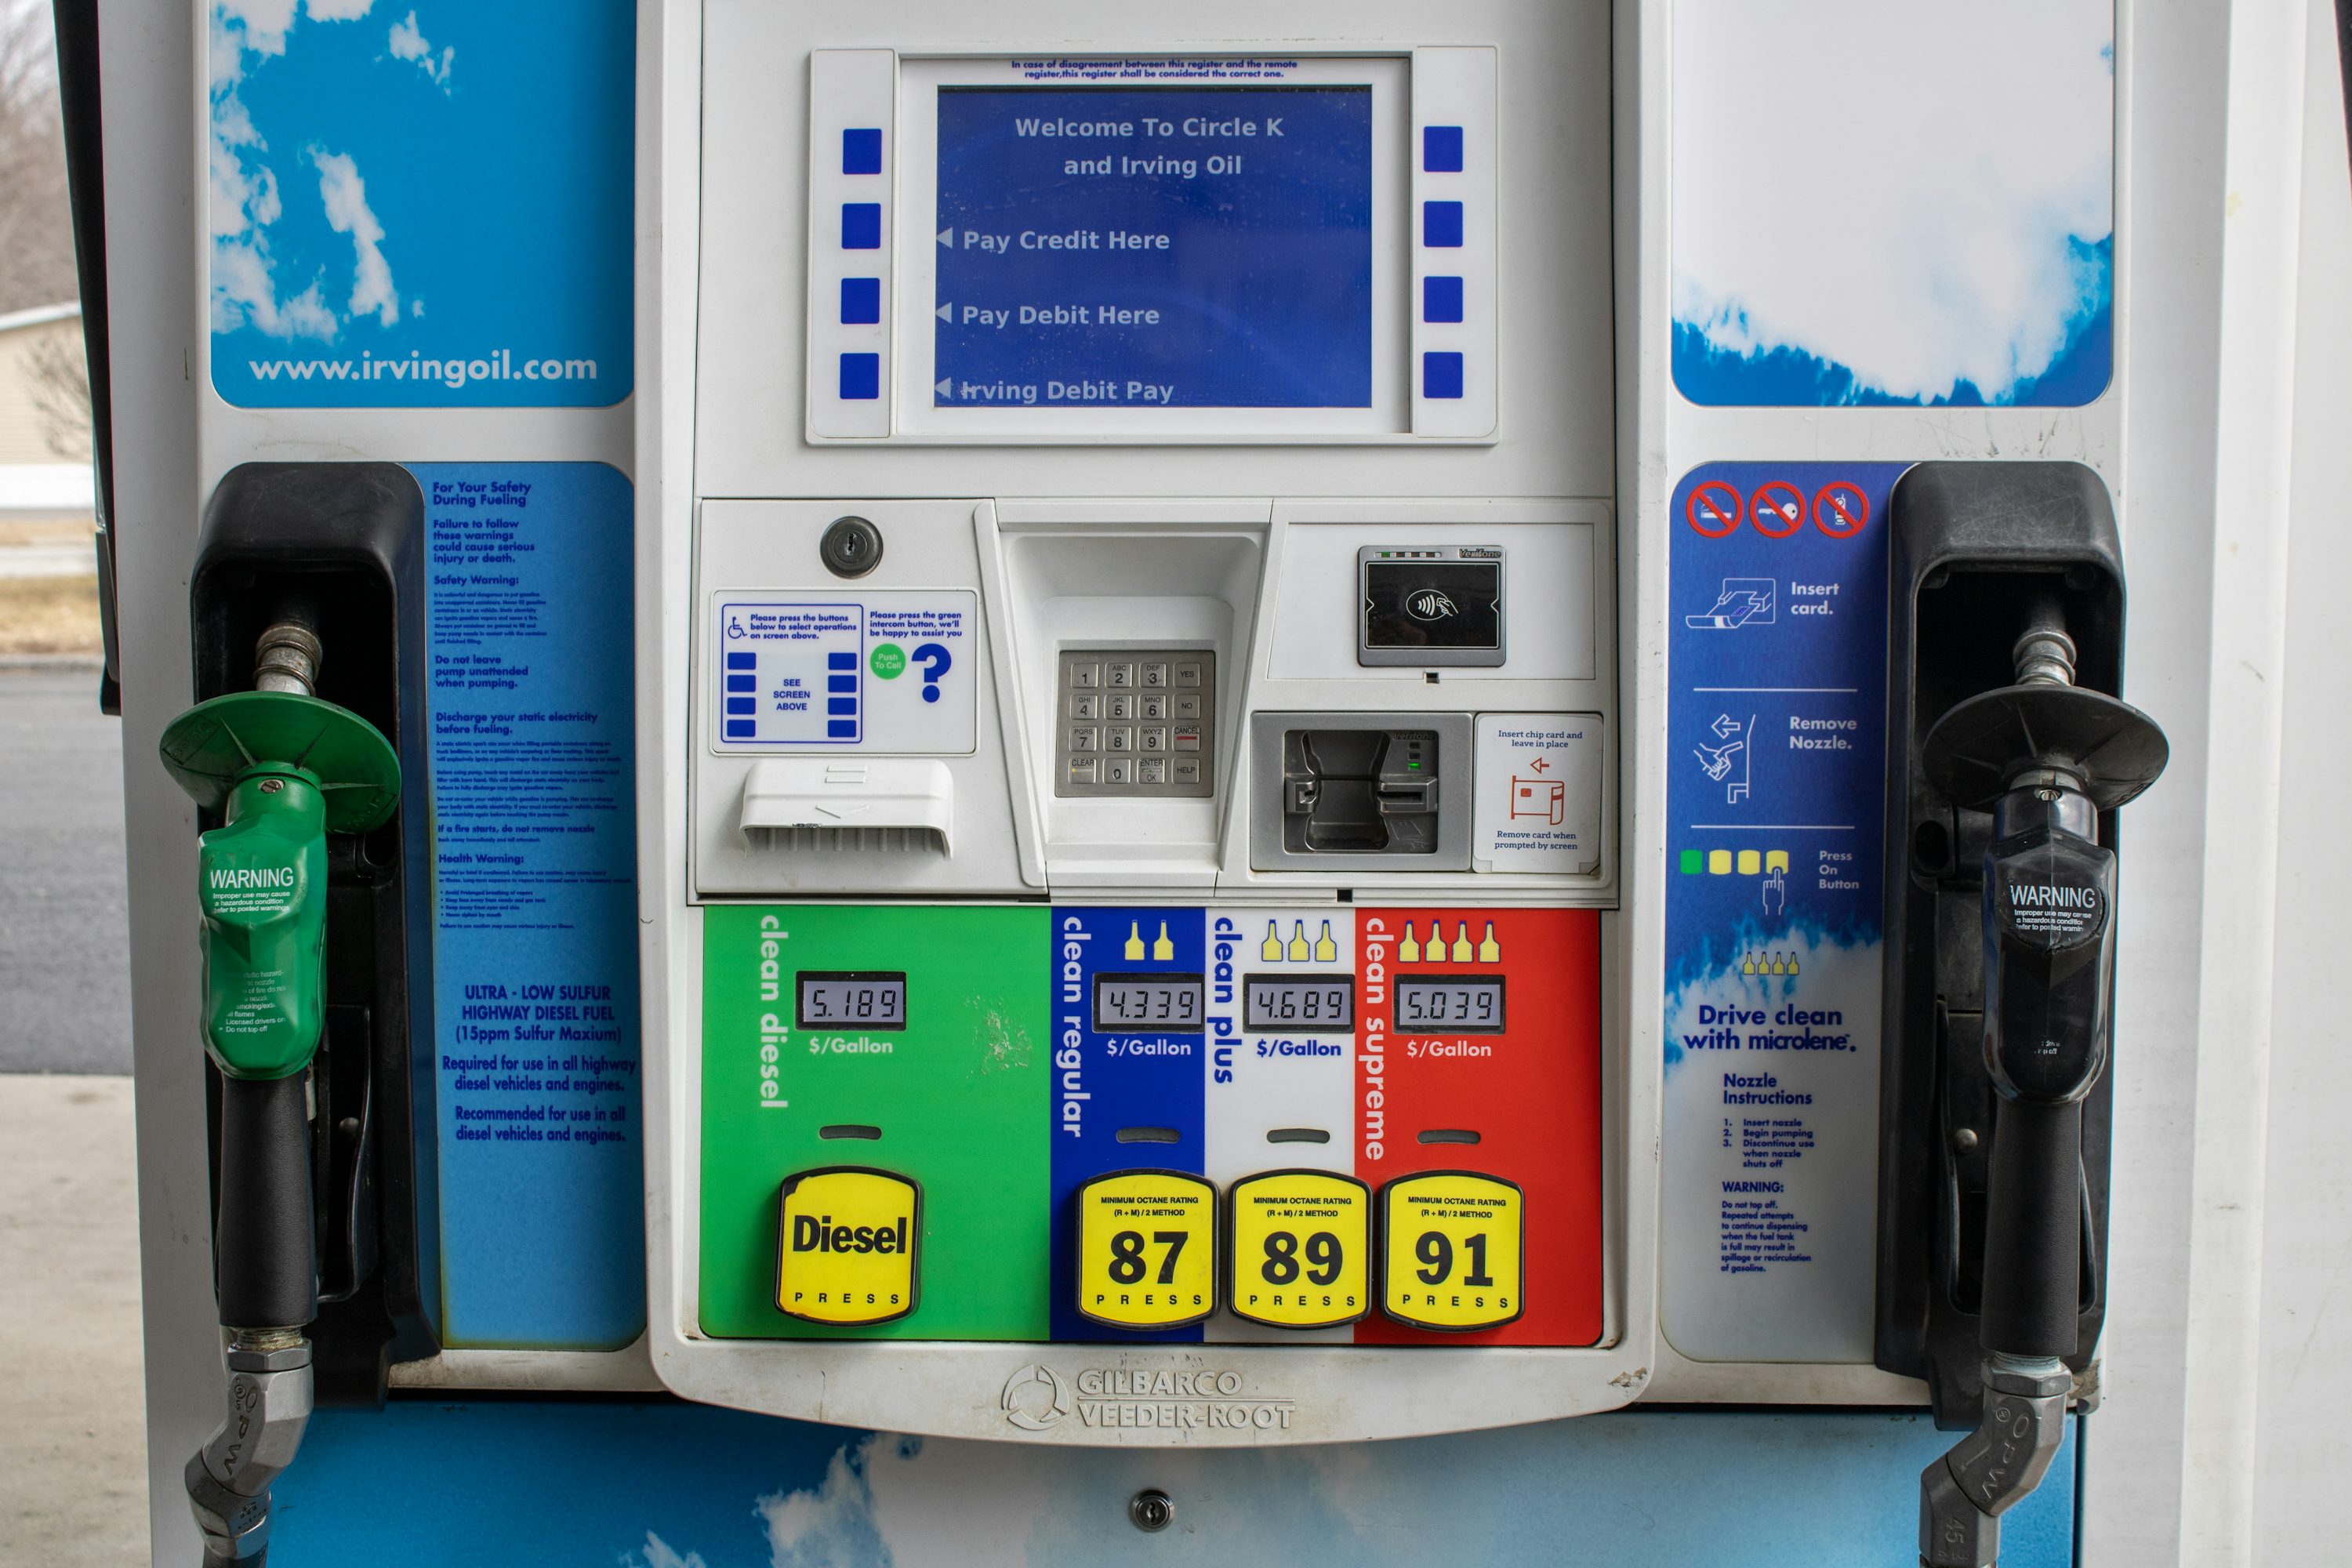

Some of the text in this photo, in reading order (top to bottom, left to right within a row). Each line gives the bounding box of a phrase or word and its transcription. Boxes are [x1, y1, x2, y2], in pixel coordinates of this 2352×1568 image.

[1059, 61, 1122, 70] disagreement
[1188, 61, 1223, 70] register
[1082, 70, 1116, 79] register
[1016, 118, 1284, 136] Welcome To Circle K
[1065, 155, 1240, 179] and Irving Oil
[964, 230, 1170, 254] Pay Credit Here
[964, 306, 1159, 328] Pay Debit Here
[249, 350, 596, 388] www.irvingoil.com
[963, 381, 1174, 404] Irving Debit Pay
[434, 481, 532, 495] For Your Safety
[434, 494, 526, 508] During Fueling
[434, 519, 469, 528] Failure
[486, 519, 519, 528] follow
[434, 530, 514, 542] these warnings
[434, 542, 461, 551] could
[499, 542, 535, 551] serious
[434, 554, 464, 564] injury
[482, 553, 515, 562] death.
[1792, 582, 1839, 595] Insert
[1791, 601, 1833, 615] card.
[814, 622, 856, 632] operations
[436, 712, 597, 724] Discharge your static electricity
[1791, 717, 1857, 729] Remove
[437, 724, 513, 735] before fueling.
[1526, 731, 1544, 739] chip
[1546, 740, 1568, 749] place
[1790, 735, 1852, 749] Nozzle.
[1820, 851, 1852, 860] Press
[210, 867, 293, 888] WARNING
[1819, 865, 1838, 874] On
[1819, 879, 1859, 889] Button
[2010, 885, 2095, 908] WARNING
[466, 985, 508, 1000] ULTRA
[522, 985, 555, 1000] LOW
[560, 985, 611, 1000] SULFUR
[1207, 917, 1243, 1083] clean plus
[463, 1005, 615, 1020] HIGHWAY DIESEL FUEL
[760, 916, 789, 1107] clean diesel
[813, 990, 896, 1017] 5.189
[1109, 991, 1193, 1018] 4.339
[1258, 991, 1343, 1019] 4.689
[1408, 992, 1493, 1020] 5.039
[1700, 1004, 1842, 1025] Drive clean
[456, 1025, 621, 1044] (15ppm Sulfur Maxium)
[1056, 916, 1091, 1138] clean regular
[809, 1036, 892, 1054] $/Gallon
[1359, 917, 1394, 1160] clean supreme
[1683, 1028, 1740, 1049] with
[1107, 1039, 1190, 1057] $/Gallon
[1258, 1039, 1341, 1057] $/Gallon
[1407, 1040, 1491, 1058] $/Gallon
[1724, 1073, 1777, 1087] Nozzle
[1724, 1090, 1812, 1104] Instructions
[793, 1215, 906, 1254] Diesel
[1108, 1231, 1189, 1285] 87
[1261, 1231, 1343, 1286] 89
[1415, 1231, 1494, 1287] 91
[1077, 1369, 1242, 1396] GILBARCO
[1078, 1403, 1295, 1428] VEEDER-ROOT
